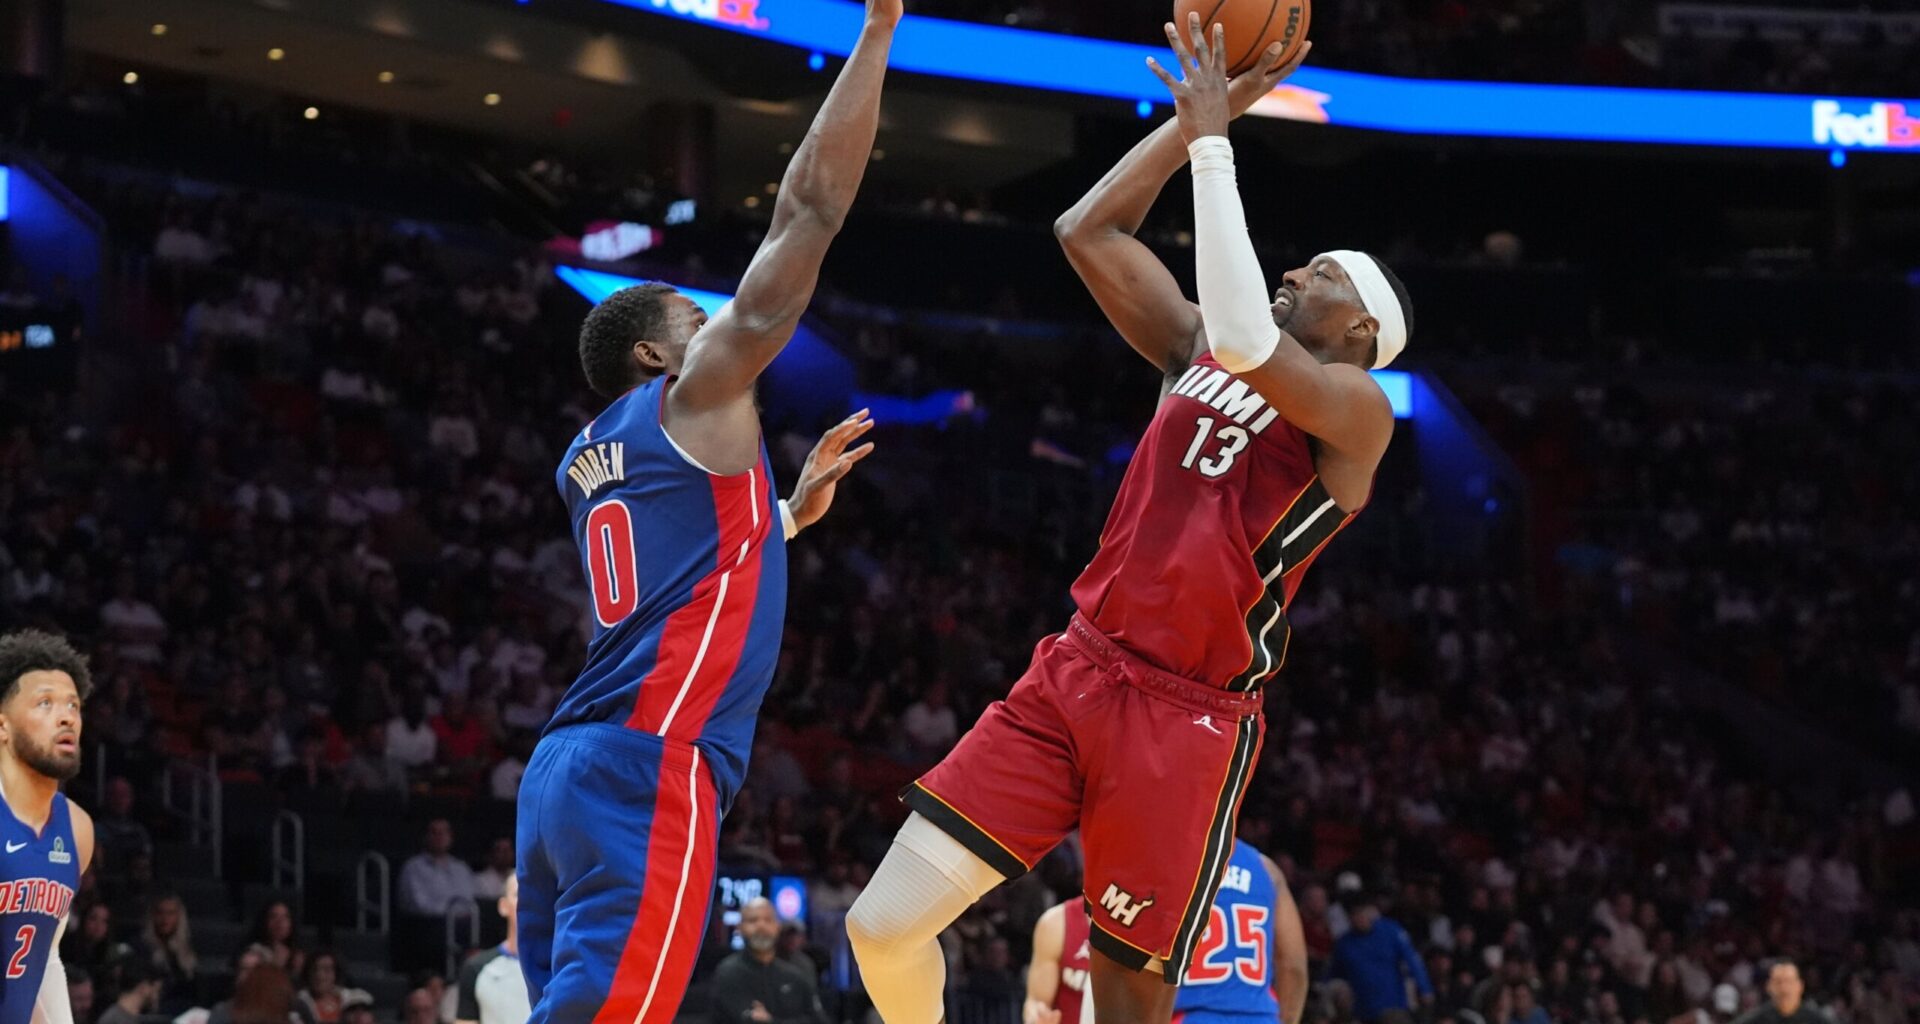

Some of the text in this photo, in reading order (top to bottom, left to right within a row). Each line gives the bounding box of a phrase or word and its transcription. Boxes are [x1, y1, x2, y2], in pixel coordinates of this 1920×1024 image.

[567, 442, 625, 500] DUREN
[1180, 416, 1250, 477] 13
[586, 499, 638, 628] 0
[6, 925, 36, 979] 2
[1183, 904, 1268, 985] 25
